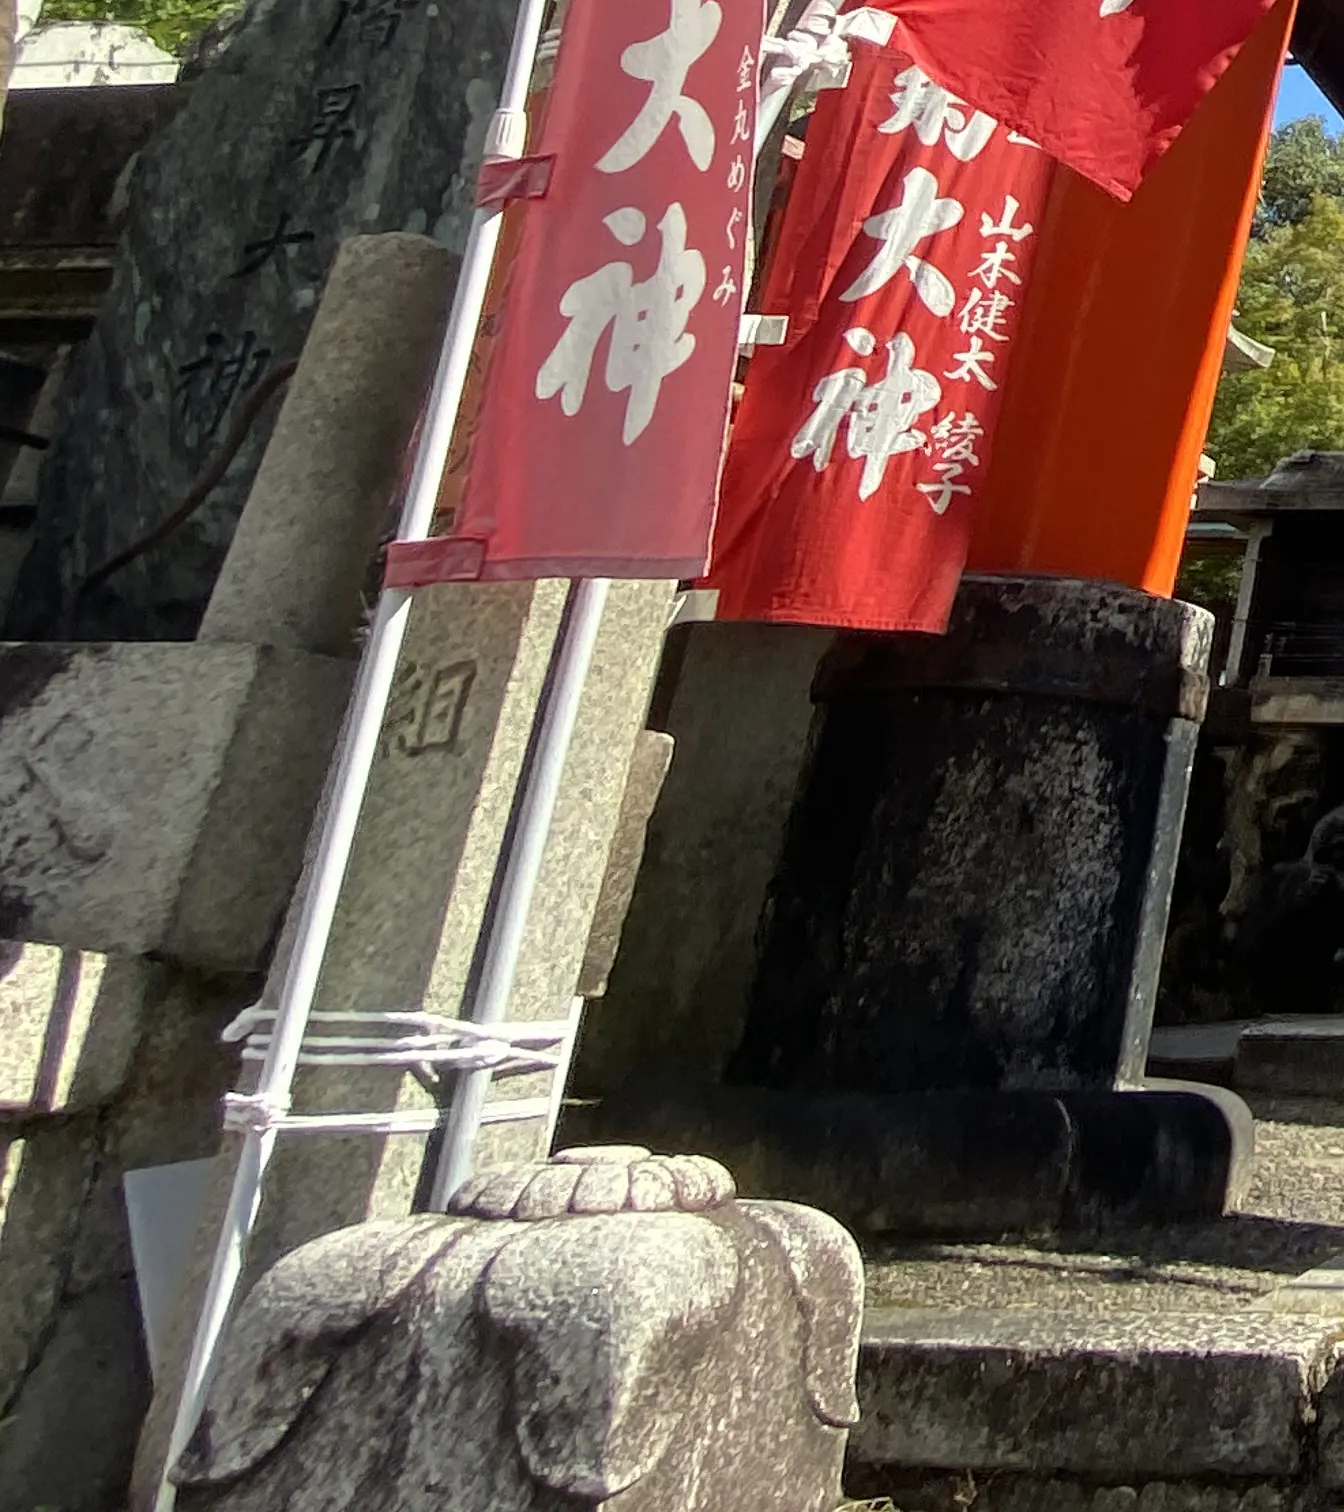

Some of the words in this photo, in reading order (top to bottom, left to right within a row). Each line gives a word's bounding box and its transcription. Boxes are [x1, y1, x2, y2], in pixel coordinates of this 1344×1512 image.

[712, 44, 756, 306] 金丸めぐみ
[957, 194, 1033, 393] 山本健太
